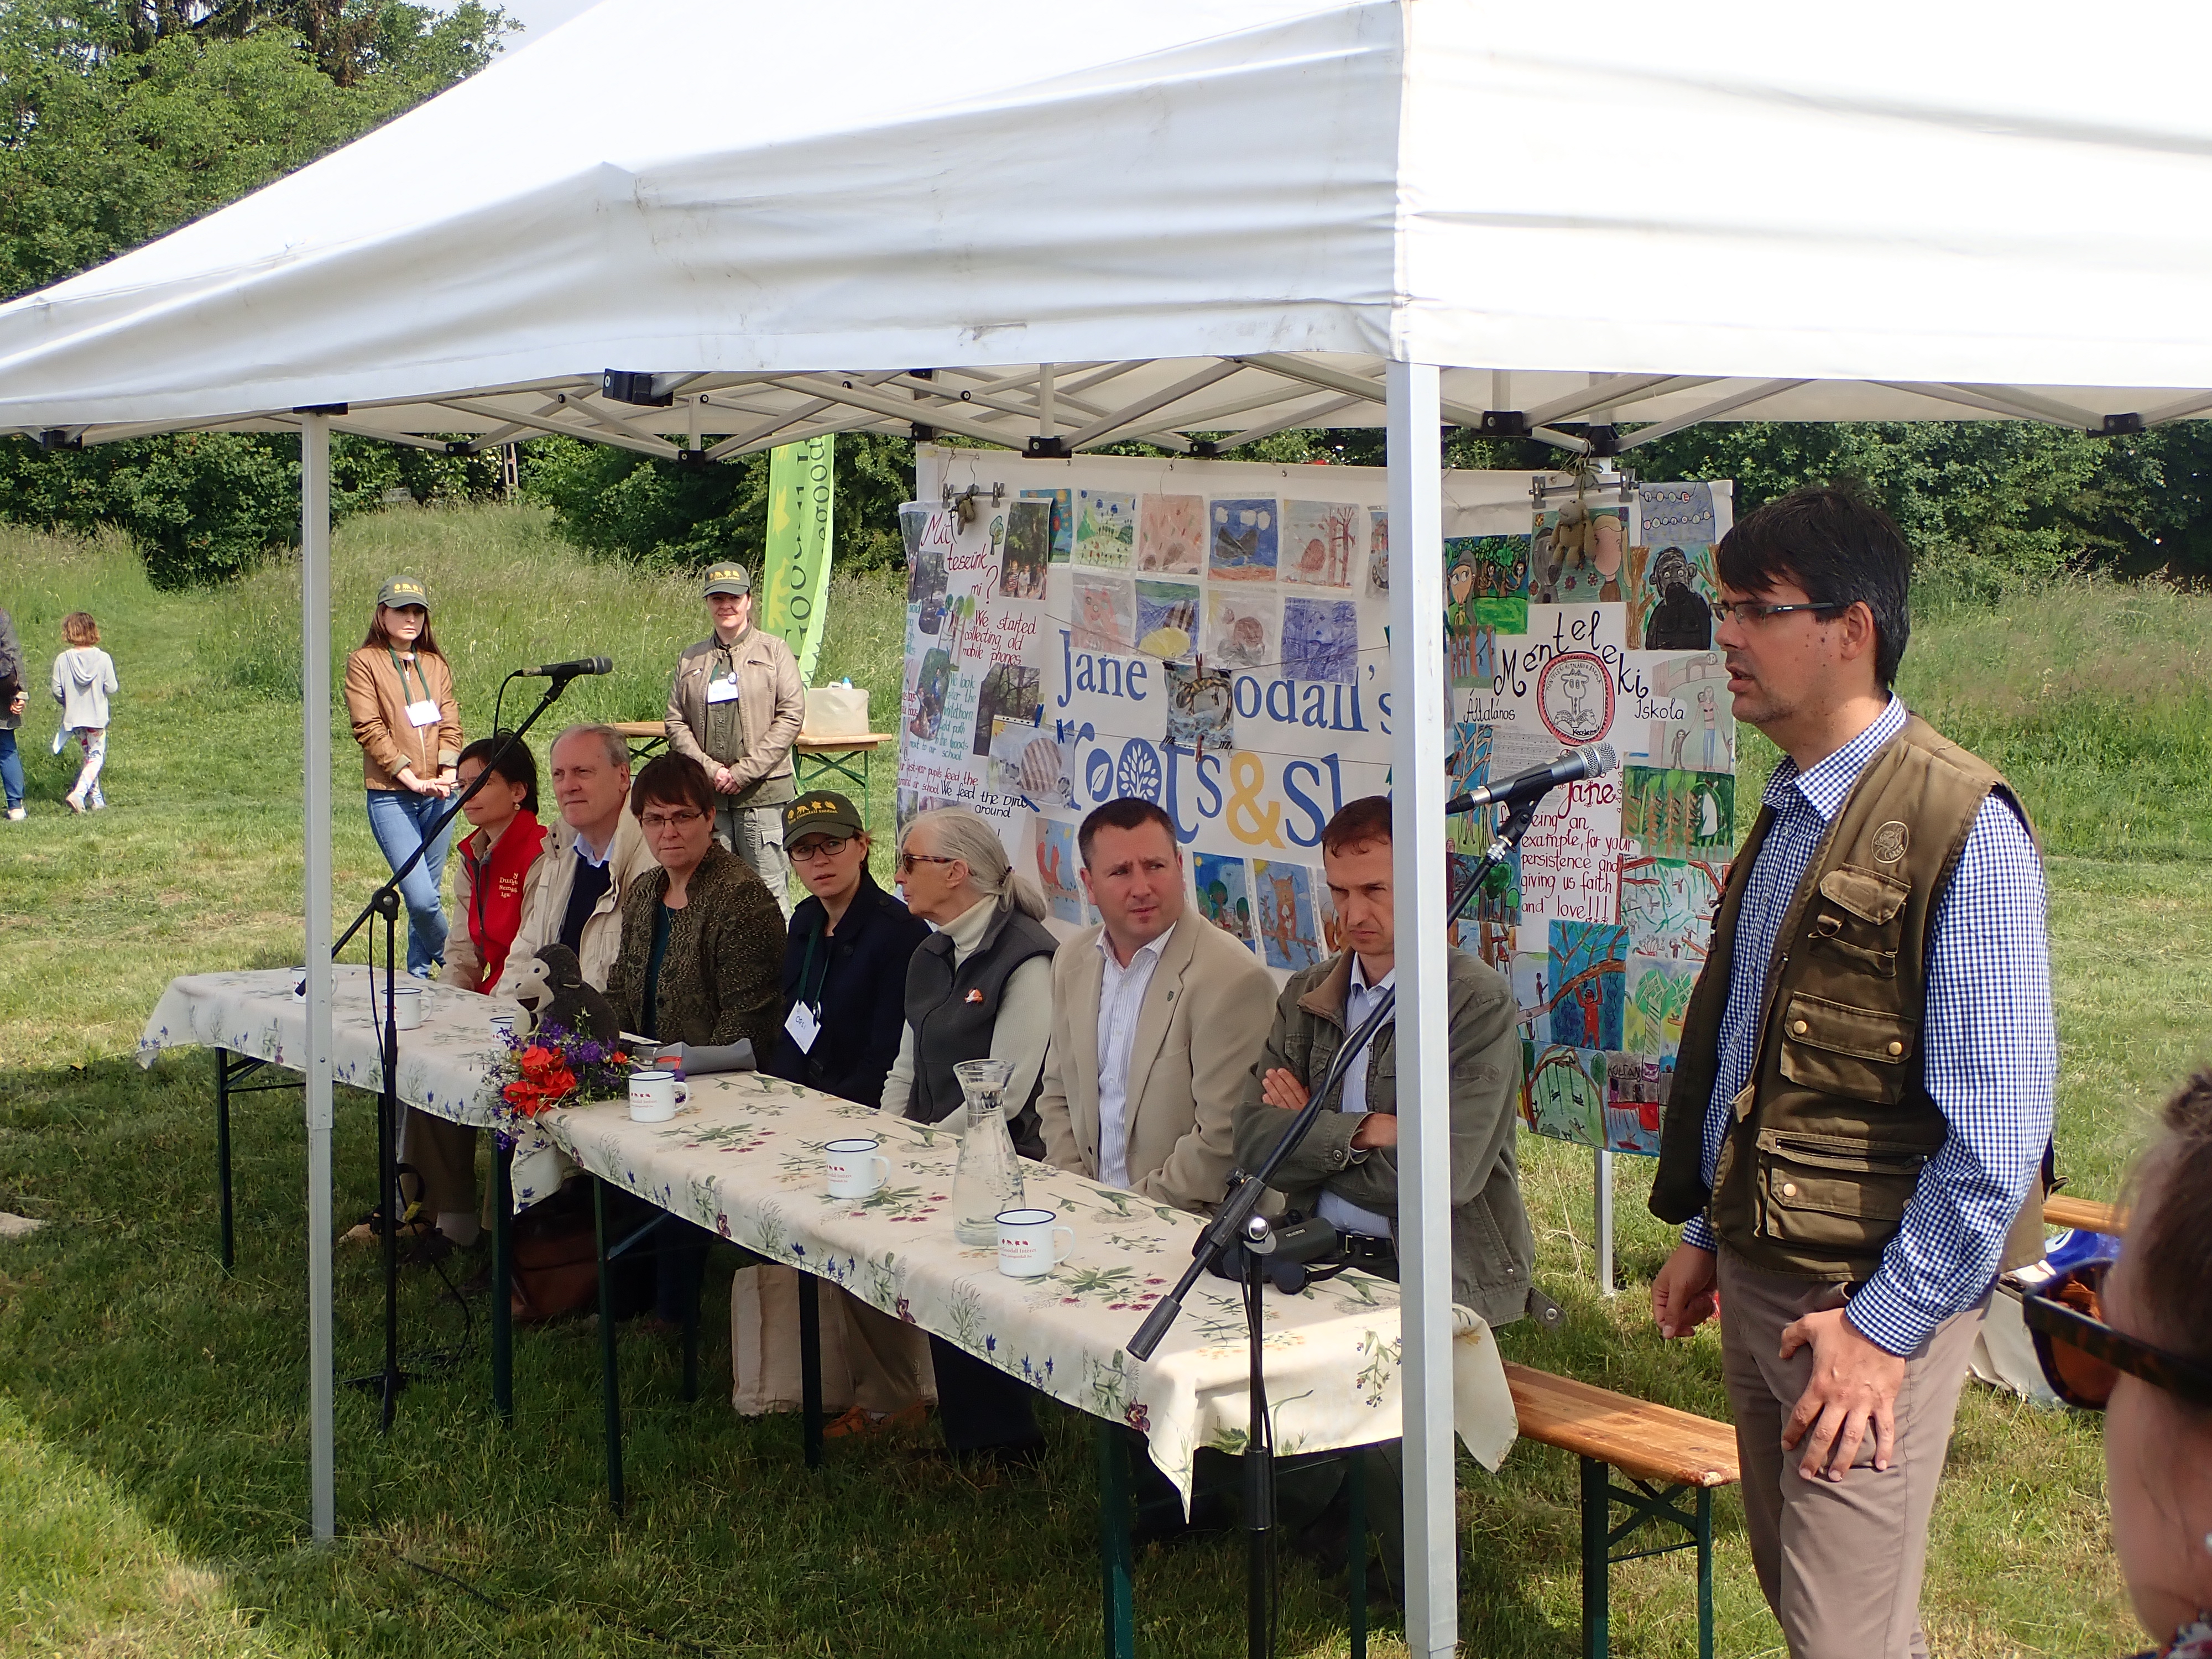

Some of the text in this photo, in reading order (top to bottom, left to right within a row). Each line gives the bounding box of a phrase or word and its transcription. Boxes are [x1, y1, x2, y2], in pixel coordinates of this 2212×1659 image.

[947, 544, 988, 571] teszünk
[971, 582, 983, 597] mi
[975, 609, 1036, 634] We started
[964, 626, 1024, 651] collecting old
[962, 644, 984, 660] mobile
[1056, 629, 1148, 708] Jane
[959, 673, 975, 689] look
[964, 689, 977, 703] the
[1463, 688, 1684, 723] Általános Iskola
[953, 722, 966, 739] path
[927, 765, 942, 783] pupils
[945, 767, 960, 782] feed
[963, 772, 978, 786] the
[941, 780, 953, 796] We
[956, 783, 975, 802] feed
[980, 791, 999, 805] the
[975, 805, 1011, 818] around
[1531, 811, 1558, 836] eing
[1569, 817, 1589, 830] an
[1521, 828, 1635, 857] example, for your
[1521, 849, 1592, 872] persistence
[1521, 871, 1612, 901] giving us faith
[1521, 898, 1543, 914] and
